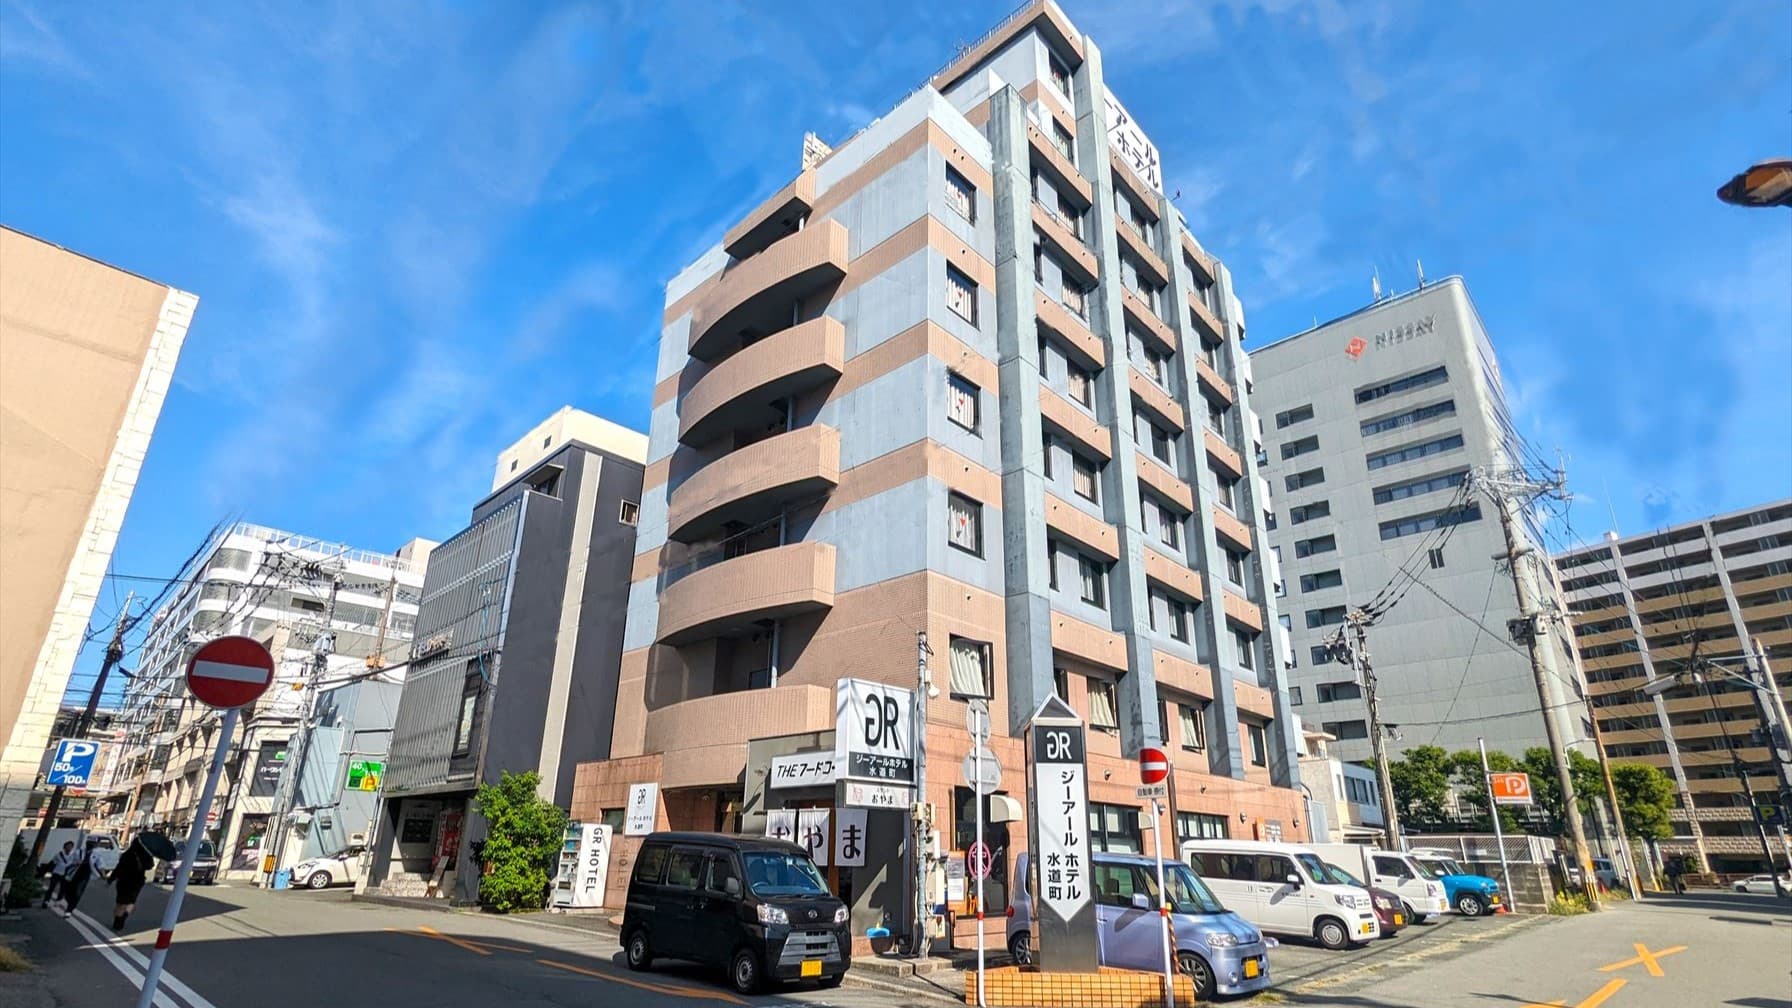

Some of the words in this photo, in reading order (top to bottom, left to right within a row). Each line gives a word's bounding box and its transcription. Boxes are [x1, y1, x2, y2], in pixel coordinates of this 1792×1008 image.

[1117, 131, 1159, 188] ホテル
[62, 743, 95, 762] P
[856, 754, 908, 769] ジーアールホテル
[869, 766, 896, 778] 水道町
[871, 794, 893, 805] おやま
[1760, 807, 1776, 820] P
[592, 827, 604, 844] GR
[585, 848, 600, 894] HOTEL
[1047, 852, 1062, 901] 水道町
